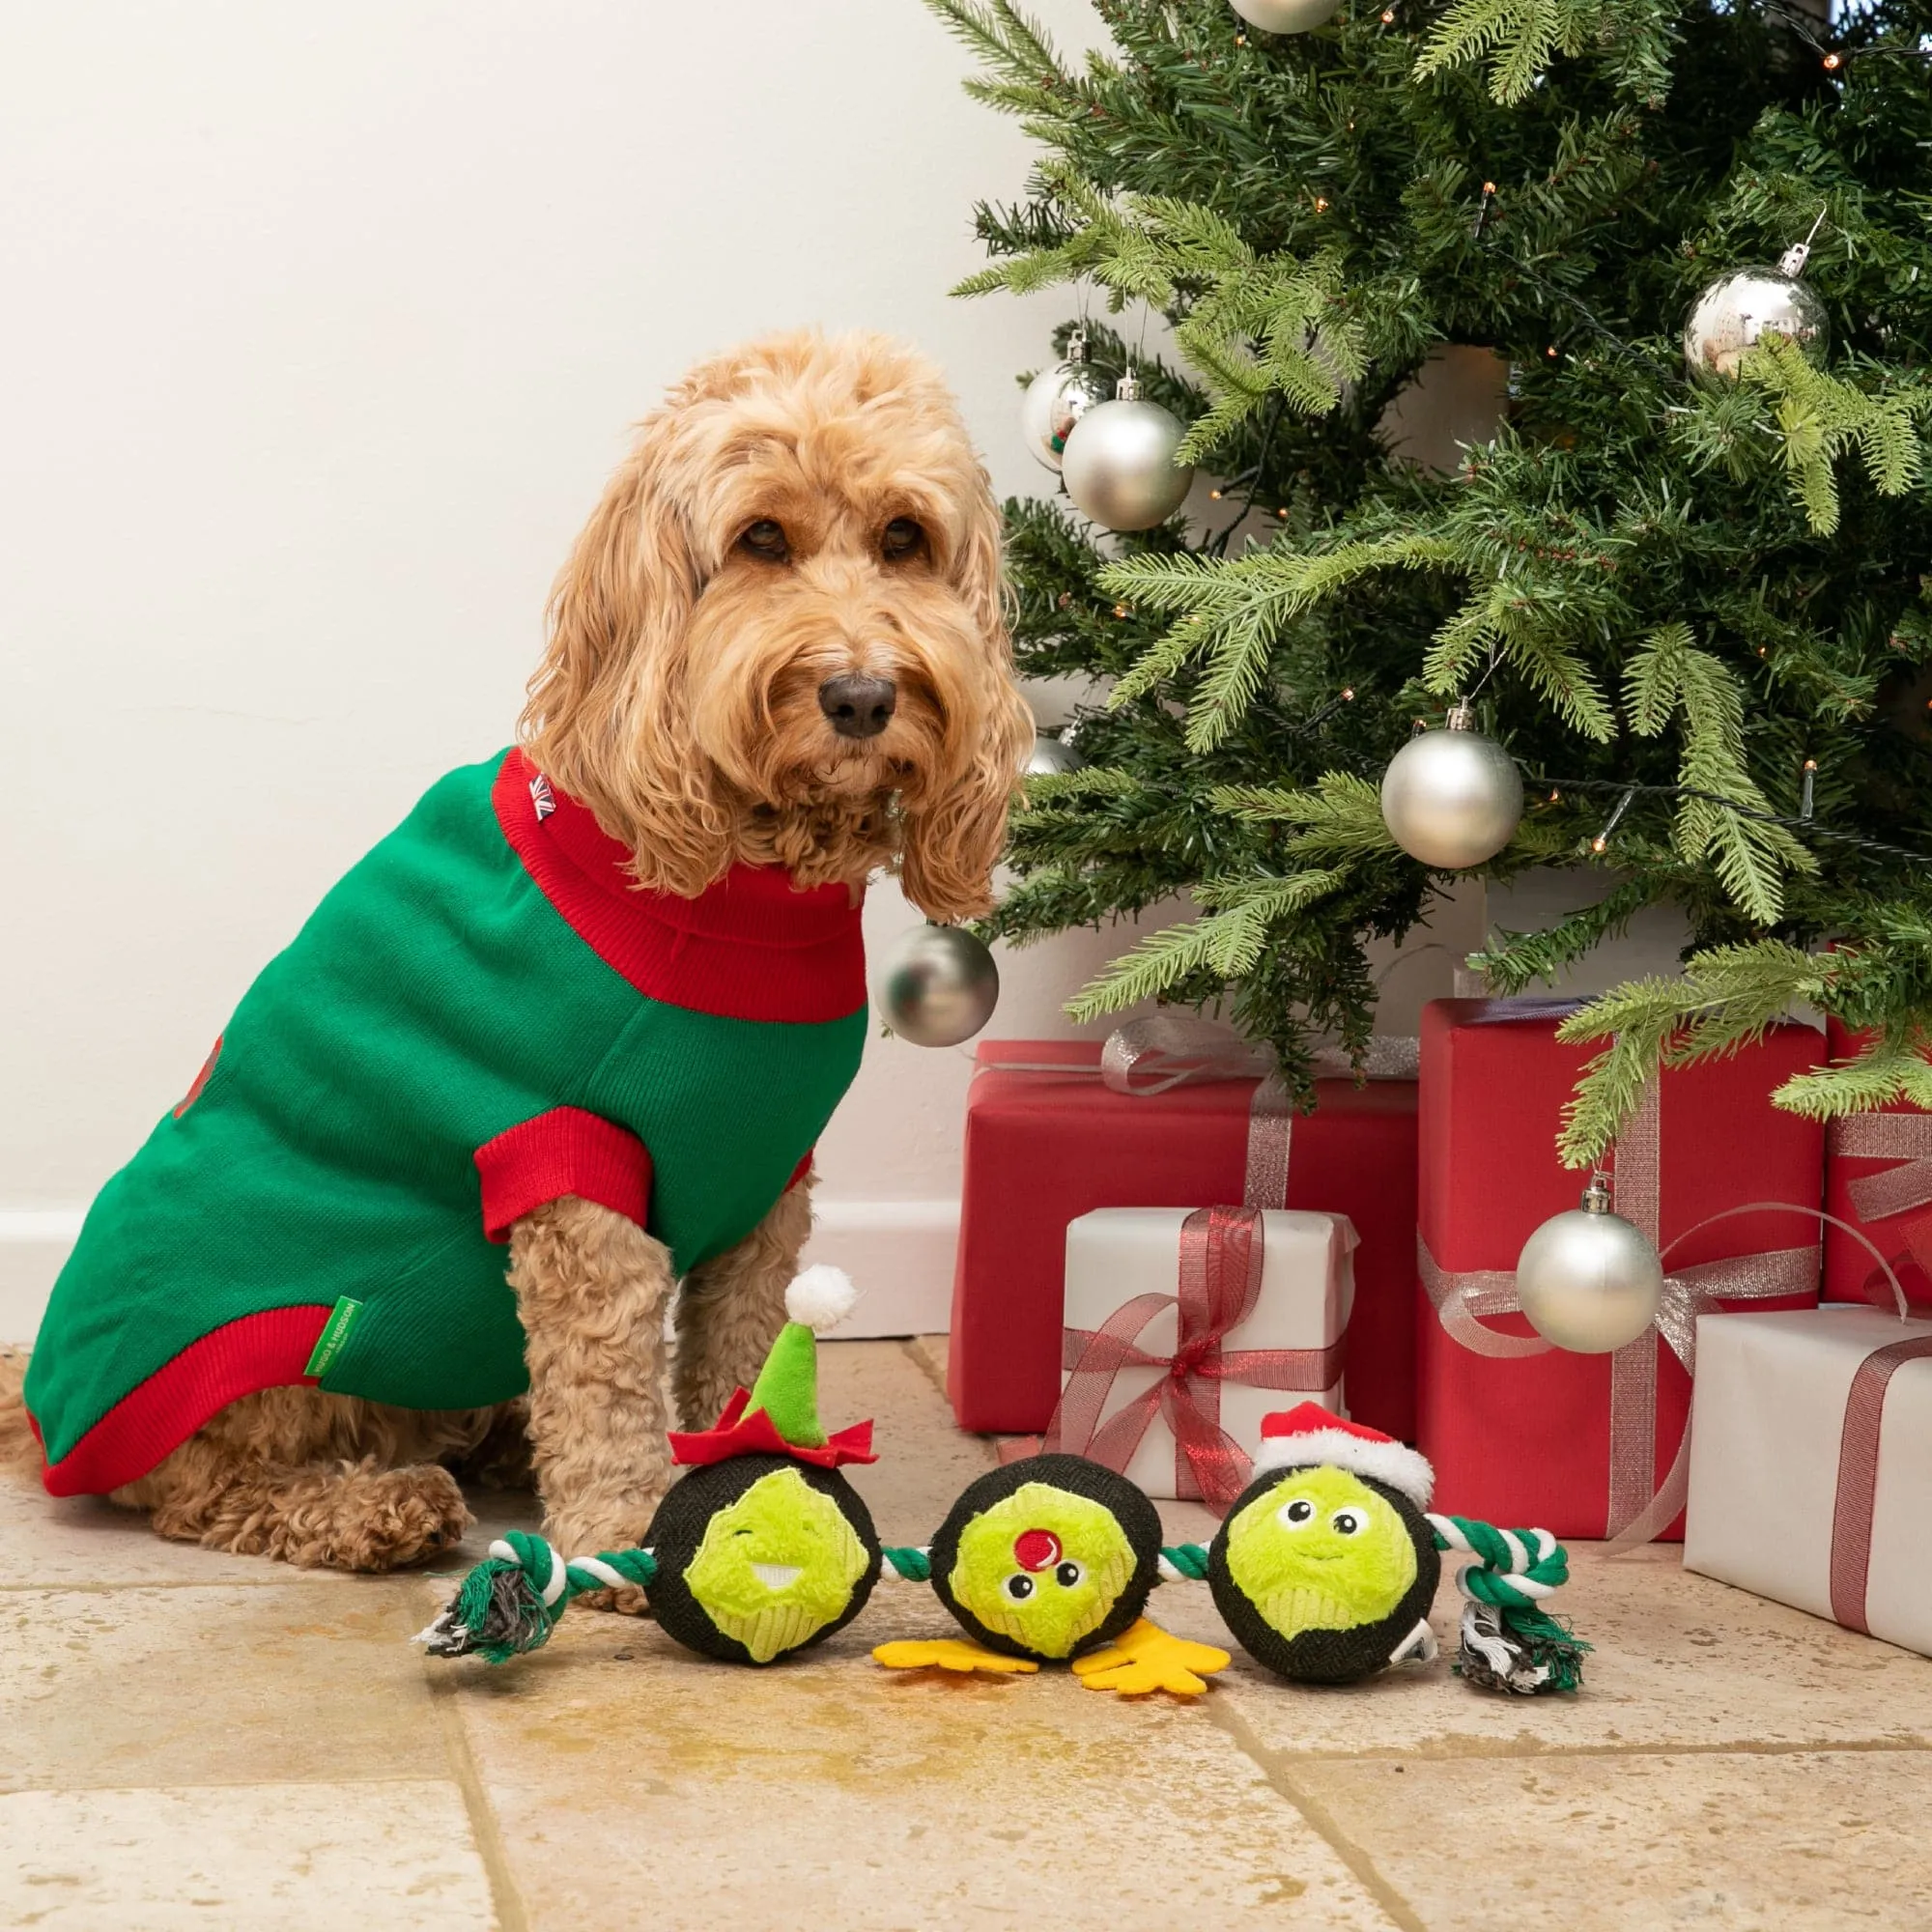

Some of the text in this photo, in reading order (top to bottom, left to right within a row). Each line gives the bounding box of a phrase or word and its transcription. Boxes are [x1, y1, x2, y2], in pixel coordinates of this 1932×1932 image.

[331, 1303, 355, 1341] HUDSON
[327, 1341, 336, 1350] &
[314, 1349, 331, 1373] HUGO
